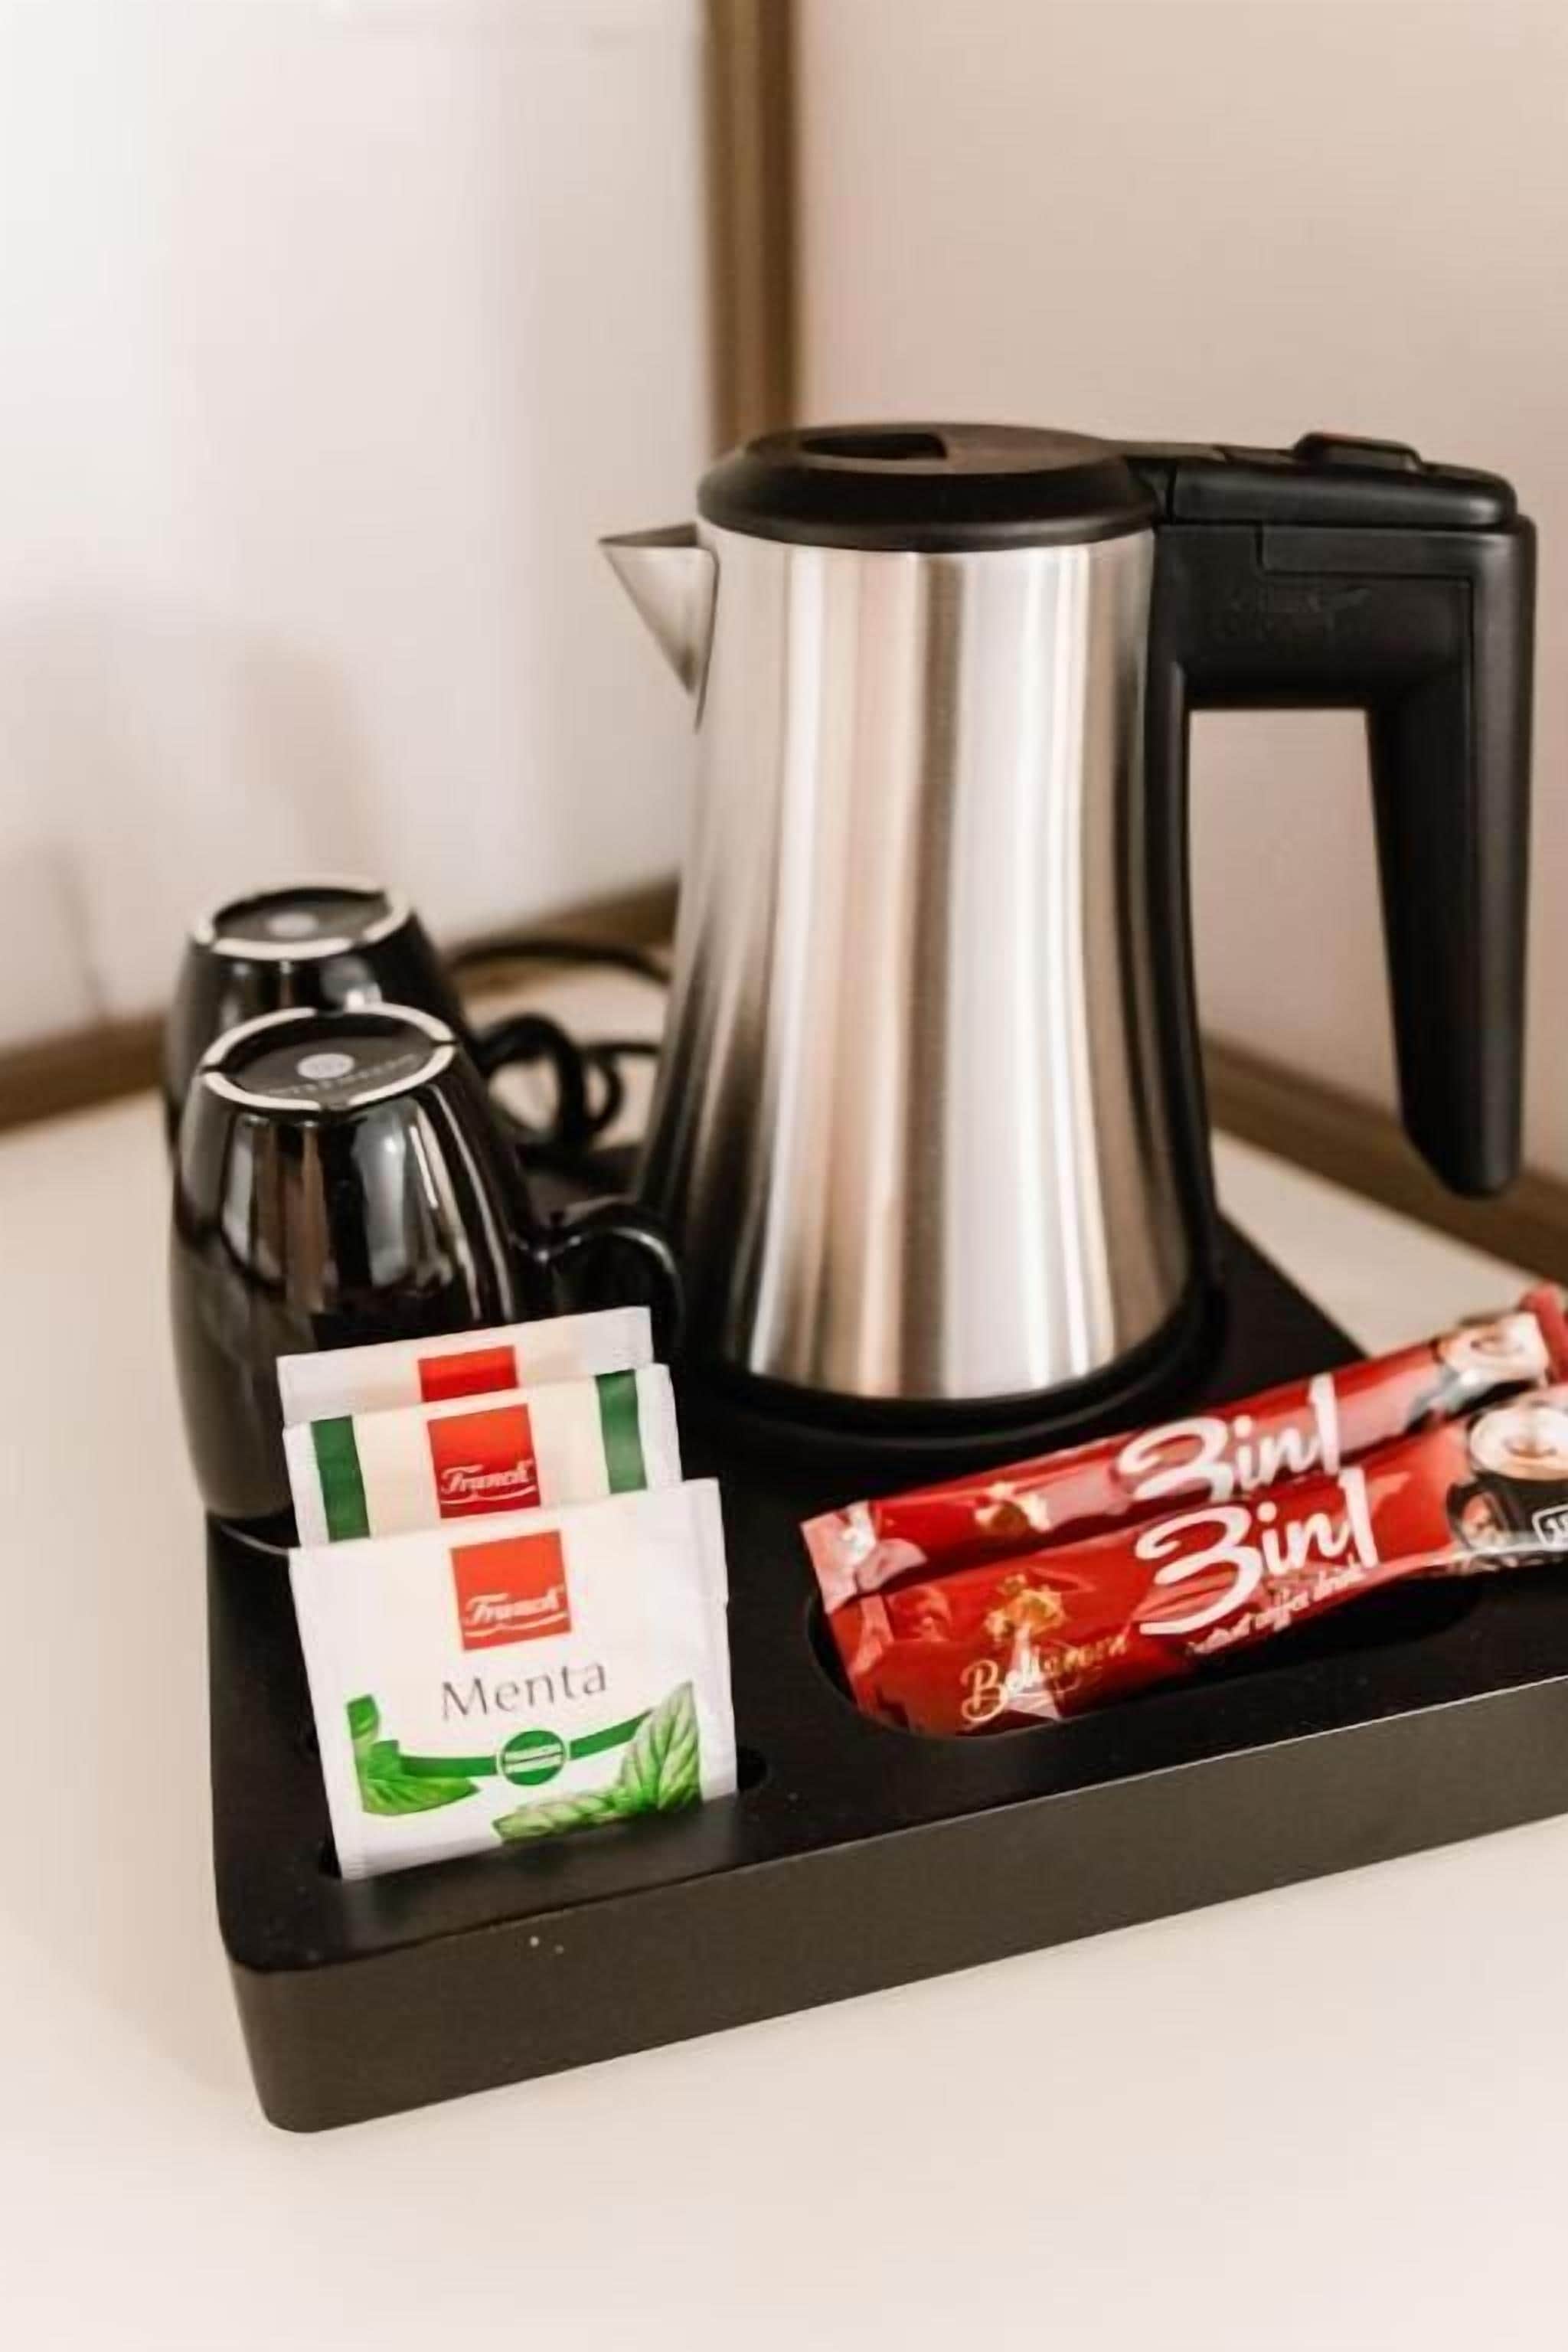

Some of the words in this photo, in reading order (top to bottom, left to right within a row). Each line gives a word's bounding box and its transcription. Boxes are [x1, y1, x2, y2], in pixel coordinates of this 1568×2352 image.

[1117, 1371, 1340, 1502] 3in1
[1135, 1465, 1378, 1635] 3in1
[442, 1662, 607, 1721] Menta
